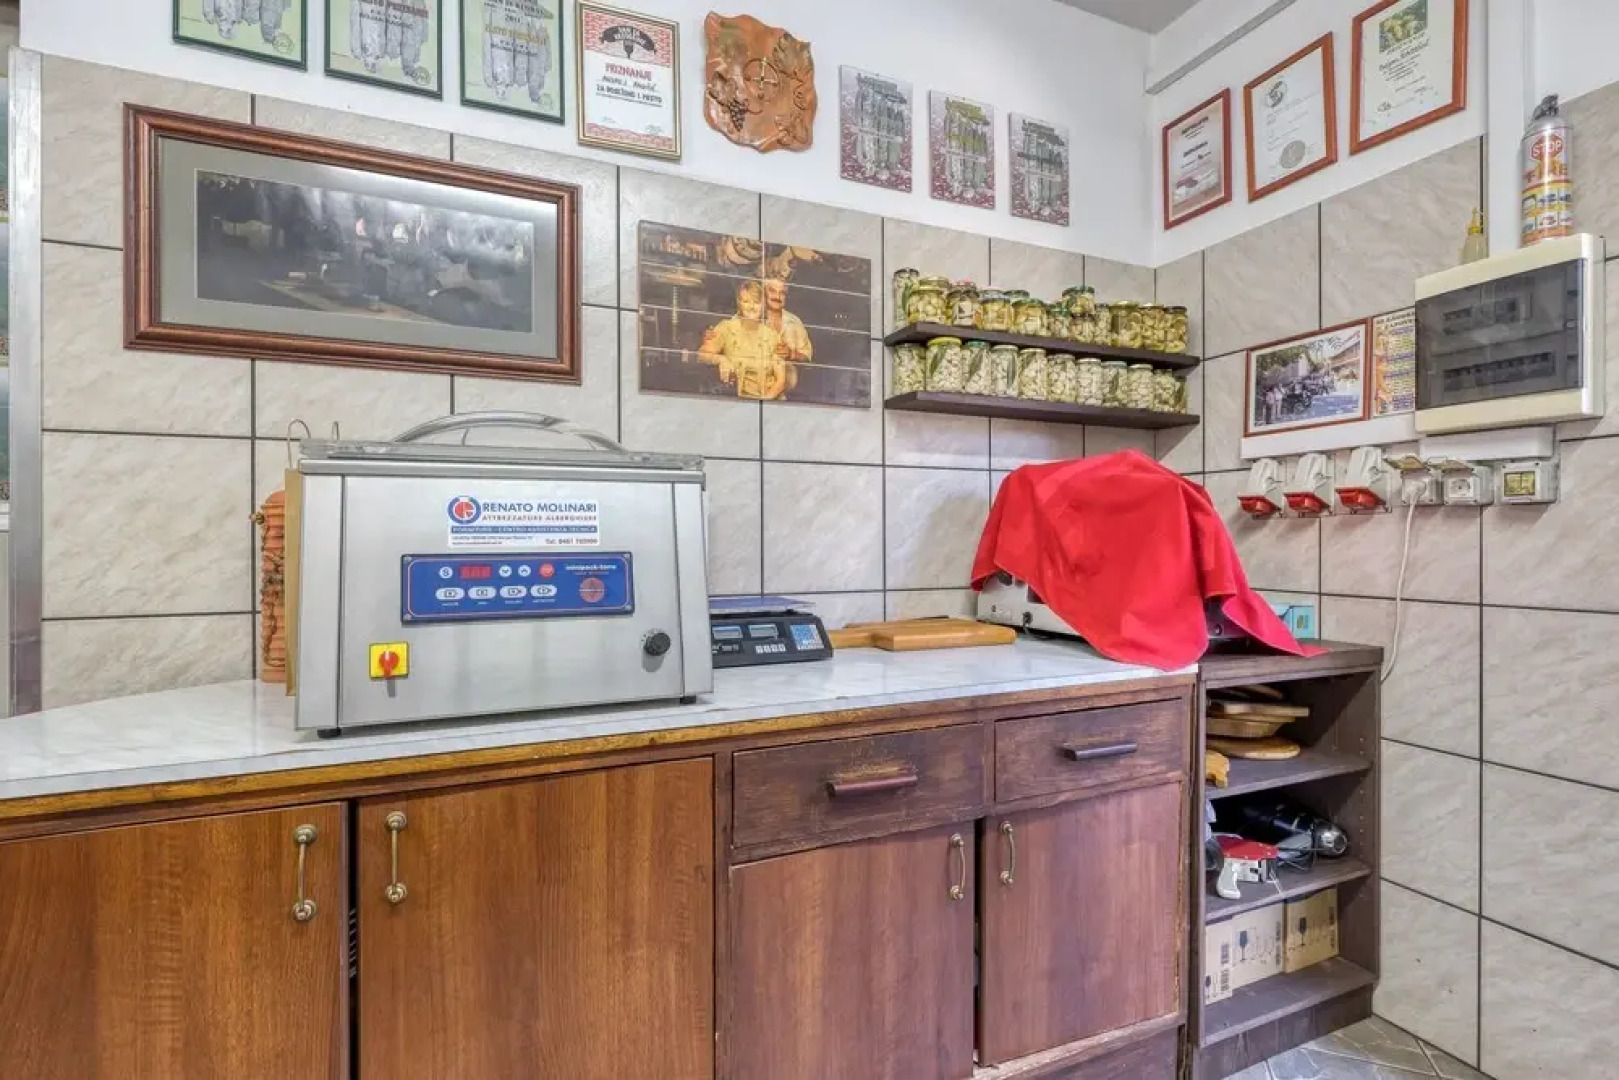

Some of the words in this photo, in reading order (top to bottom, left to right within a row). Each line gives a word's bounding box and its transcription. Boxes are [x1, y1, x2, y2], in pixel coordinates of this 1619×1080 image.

[1533, 140, 1563, 156] STOP
[482, 502, 534, 512] RENATO
[537, 502, 597, 512] MOLINARI
